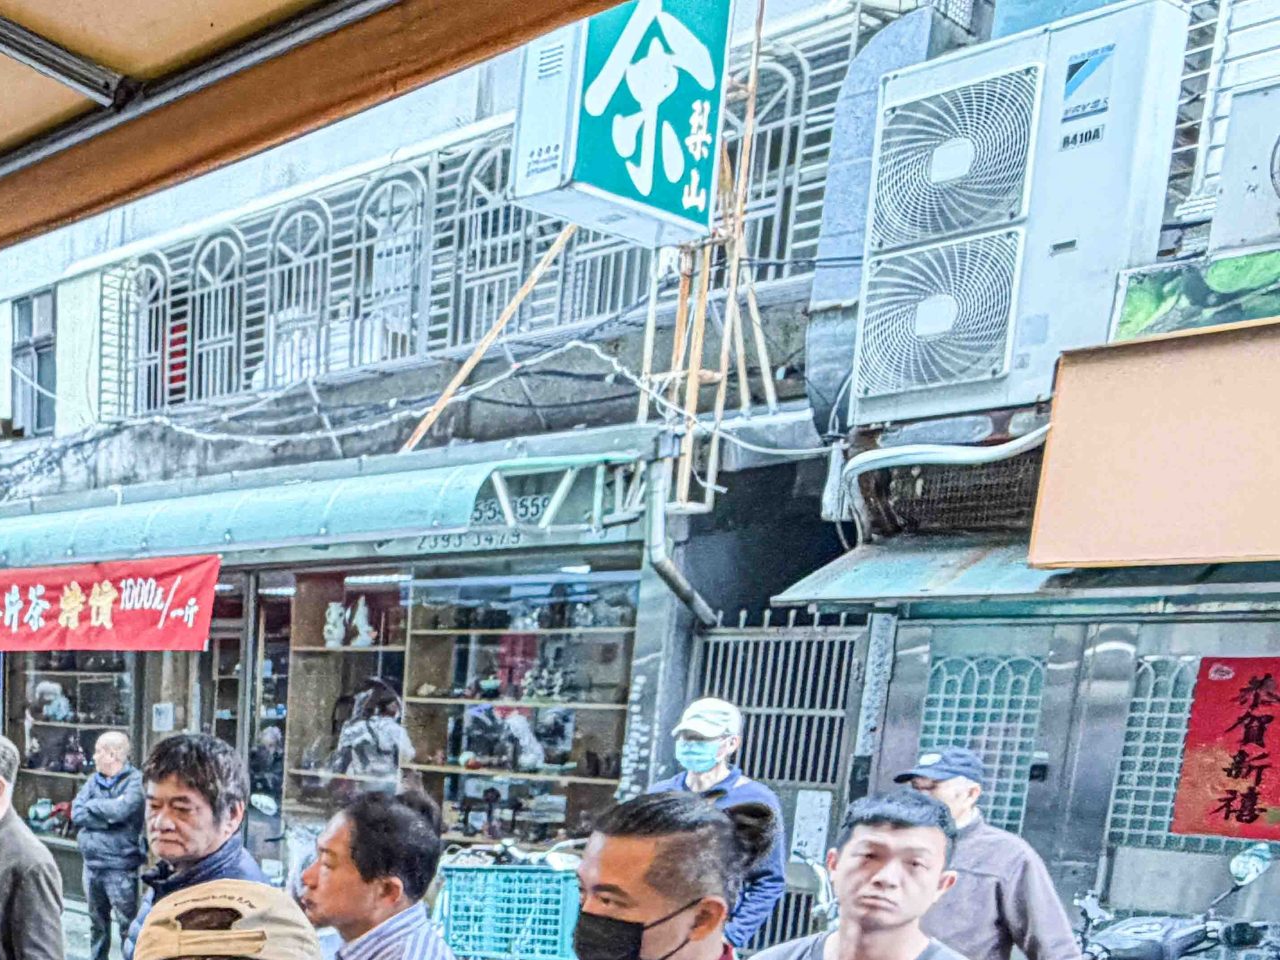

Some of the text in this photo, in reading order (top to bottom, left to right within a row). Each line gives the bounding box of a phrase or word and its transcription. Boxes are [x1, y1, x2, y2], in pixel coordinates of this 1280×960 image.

[681, 99, 713, 212] 梨山
[1209, 672, 1280, 824] 恭賀新禧
